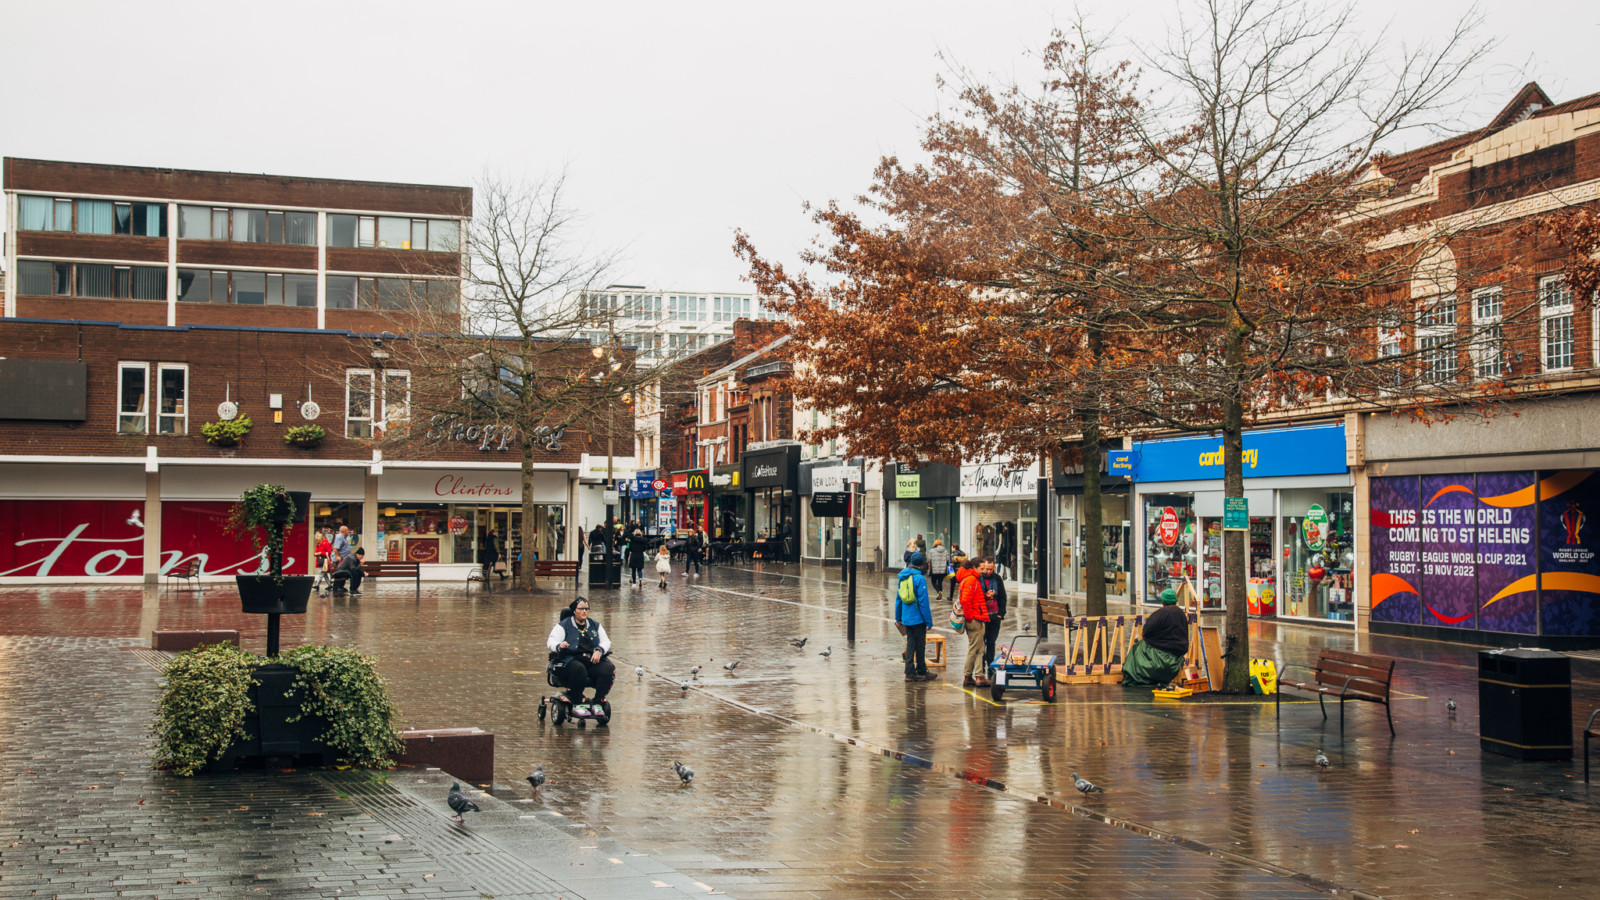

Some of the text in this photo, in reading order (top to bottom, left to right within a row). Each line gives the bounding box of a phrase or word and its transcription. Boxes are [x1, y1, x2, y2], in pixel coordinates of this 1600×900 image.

[427, 414, 564, 451] Shoppng
[434, 474, 513, 497] Clintons
[813, 477, 823, 487] NEW
[1388, 508, 1512, 525] THIS IS THE WORLD
[1389, 527, 1530, 545] COMING TO ST HELENS
[1389, 550, 1527, 566] RUGBY LEAGUE WORLD CUP 2021
[1389, 563, 1399, 574] 15
[1400, 563, 1416, 574] OCT
[1423, 564, 1434, 575] 19
[1435, 565, 1453, 576] NOV
[1453, 565, 1475, 577] 2022
